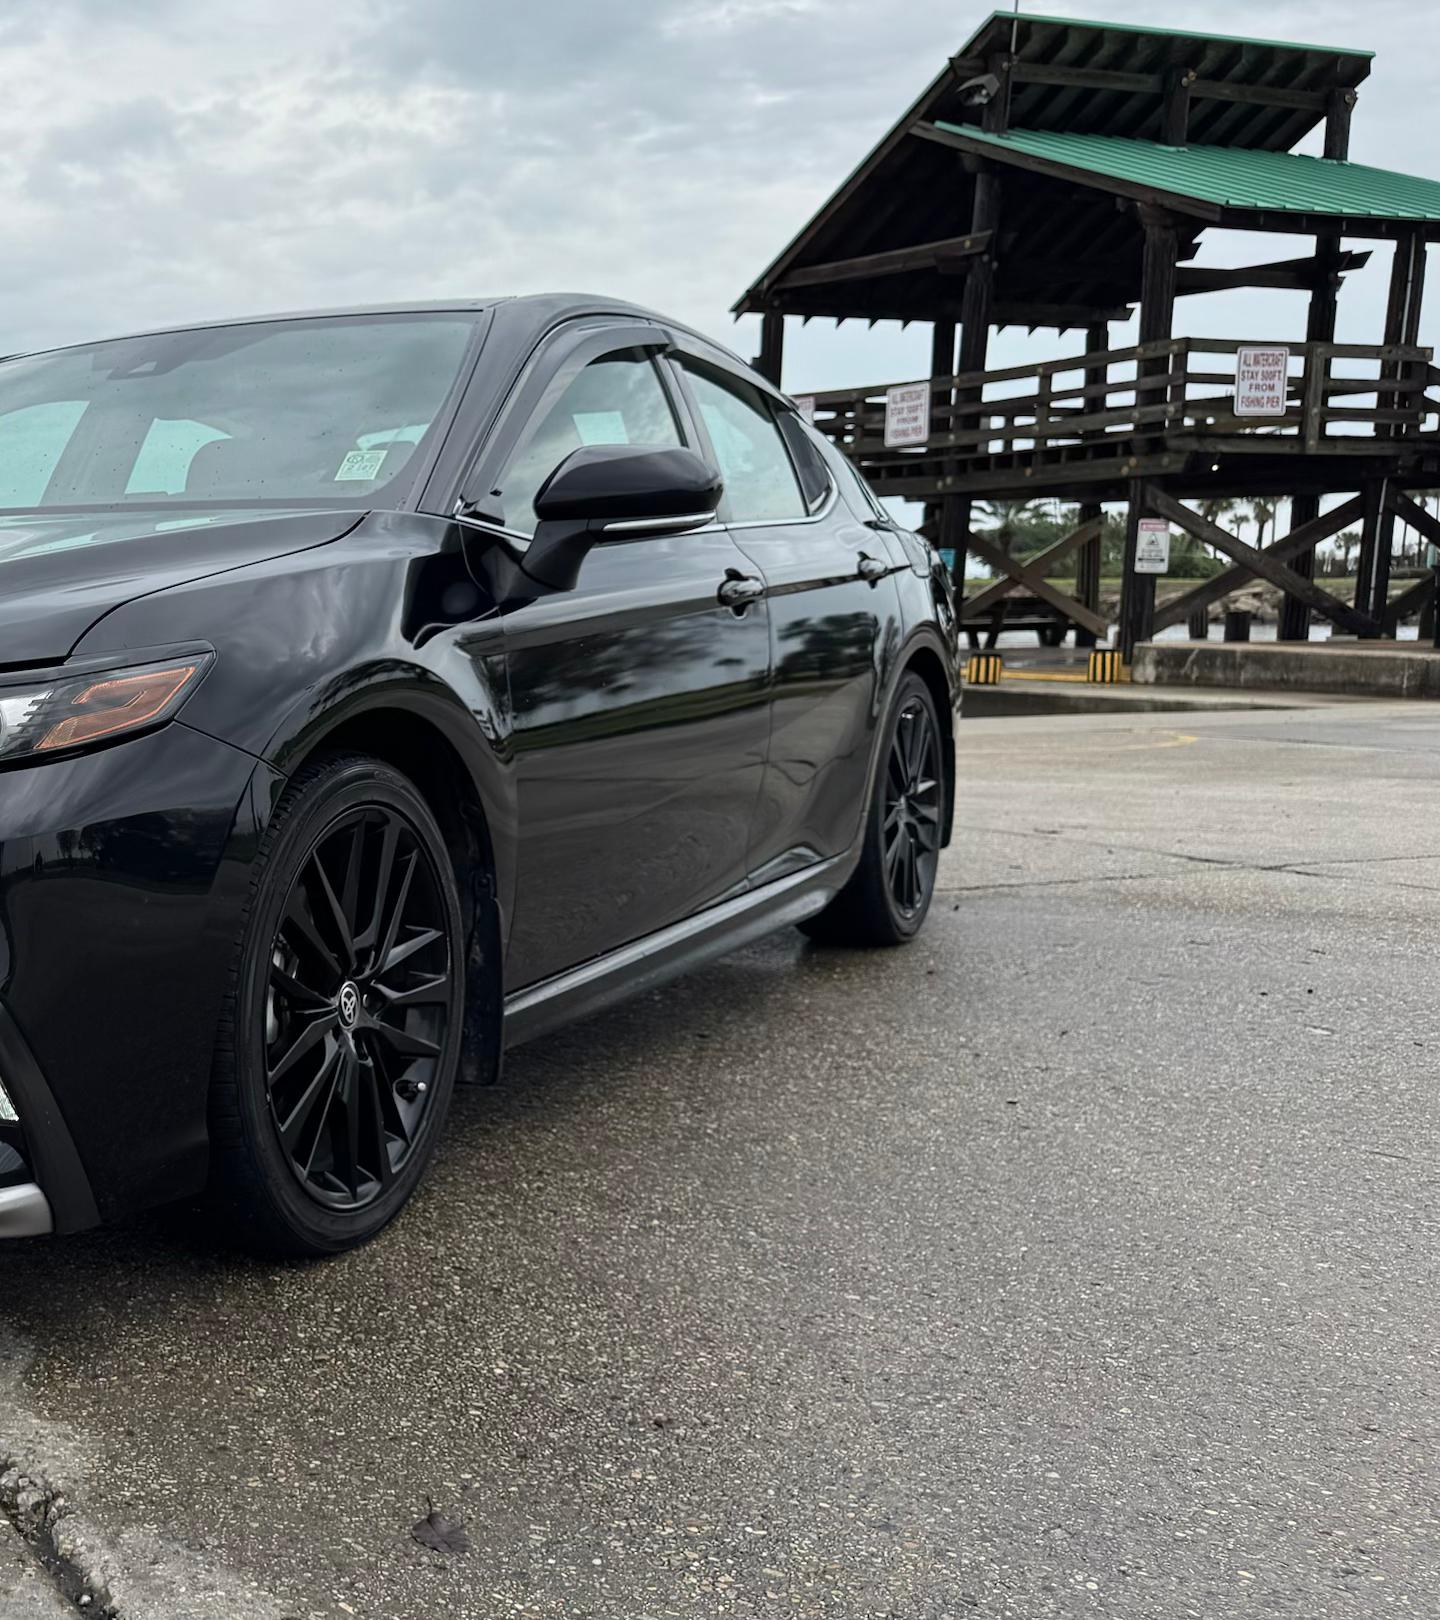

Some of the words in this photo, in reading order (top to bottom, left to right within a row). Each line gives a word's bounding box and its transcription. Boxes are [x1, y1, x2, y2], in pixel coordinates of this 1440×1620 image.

[1241, 370, 1259, 381] STAY
[1248, 383, 1275, 392] FROM
[1241, 396, 1265, 408] FISHING
[1266, 396, 1280, 408] PIER
